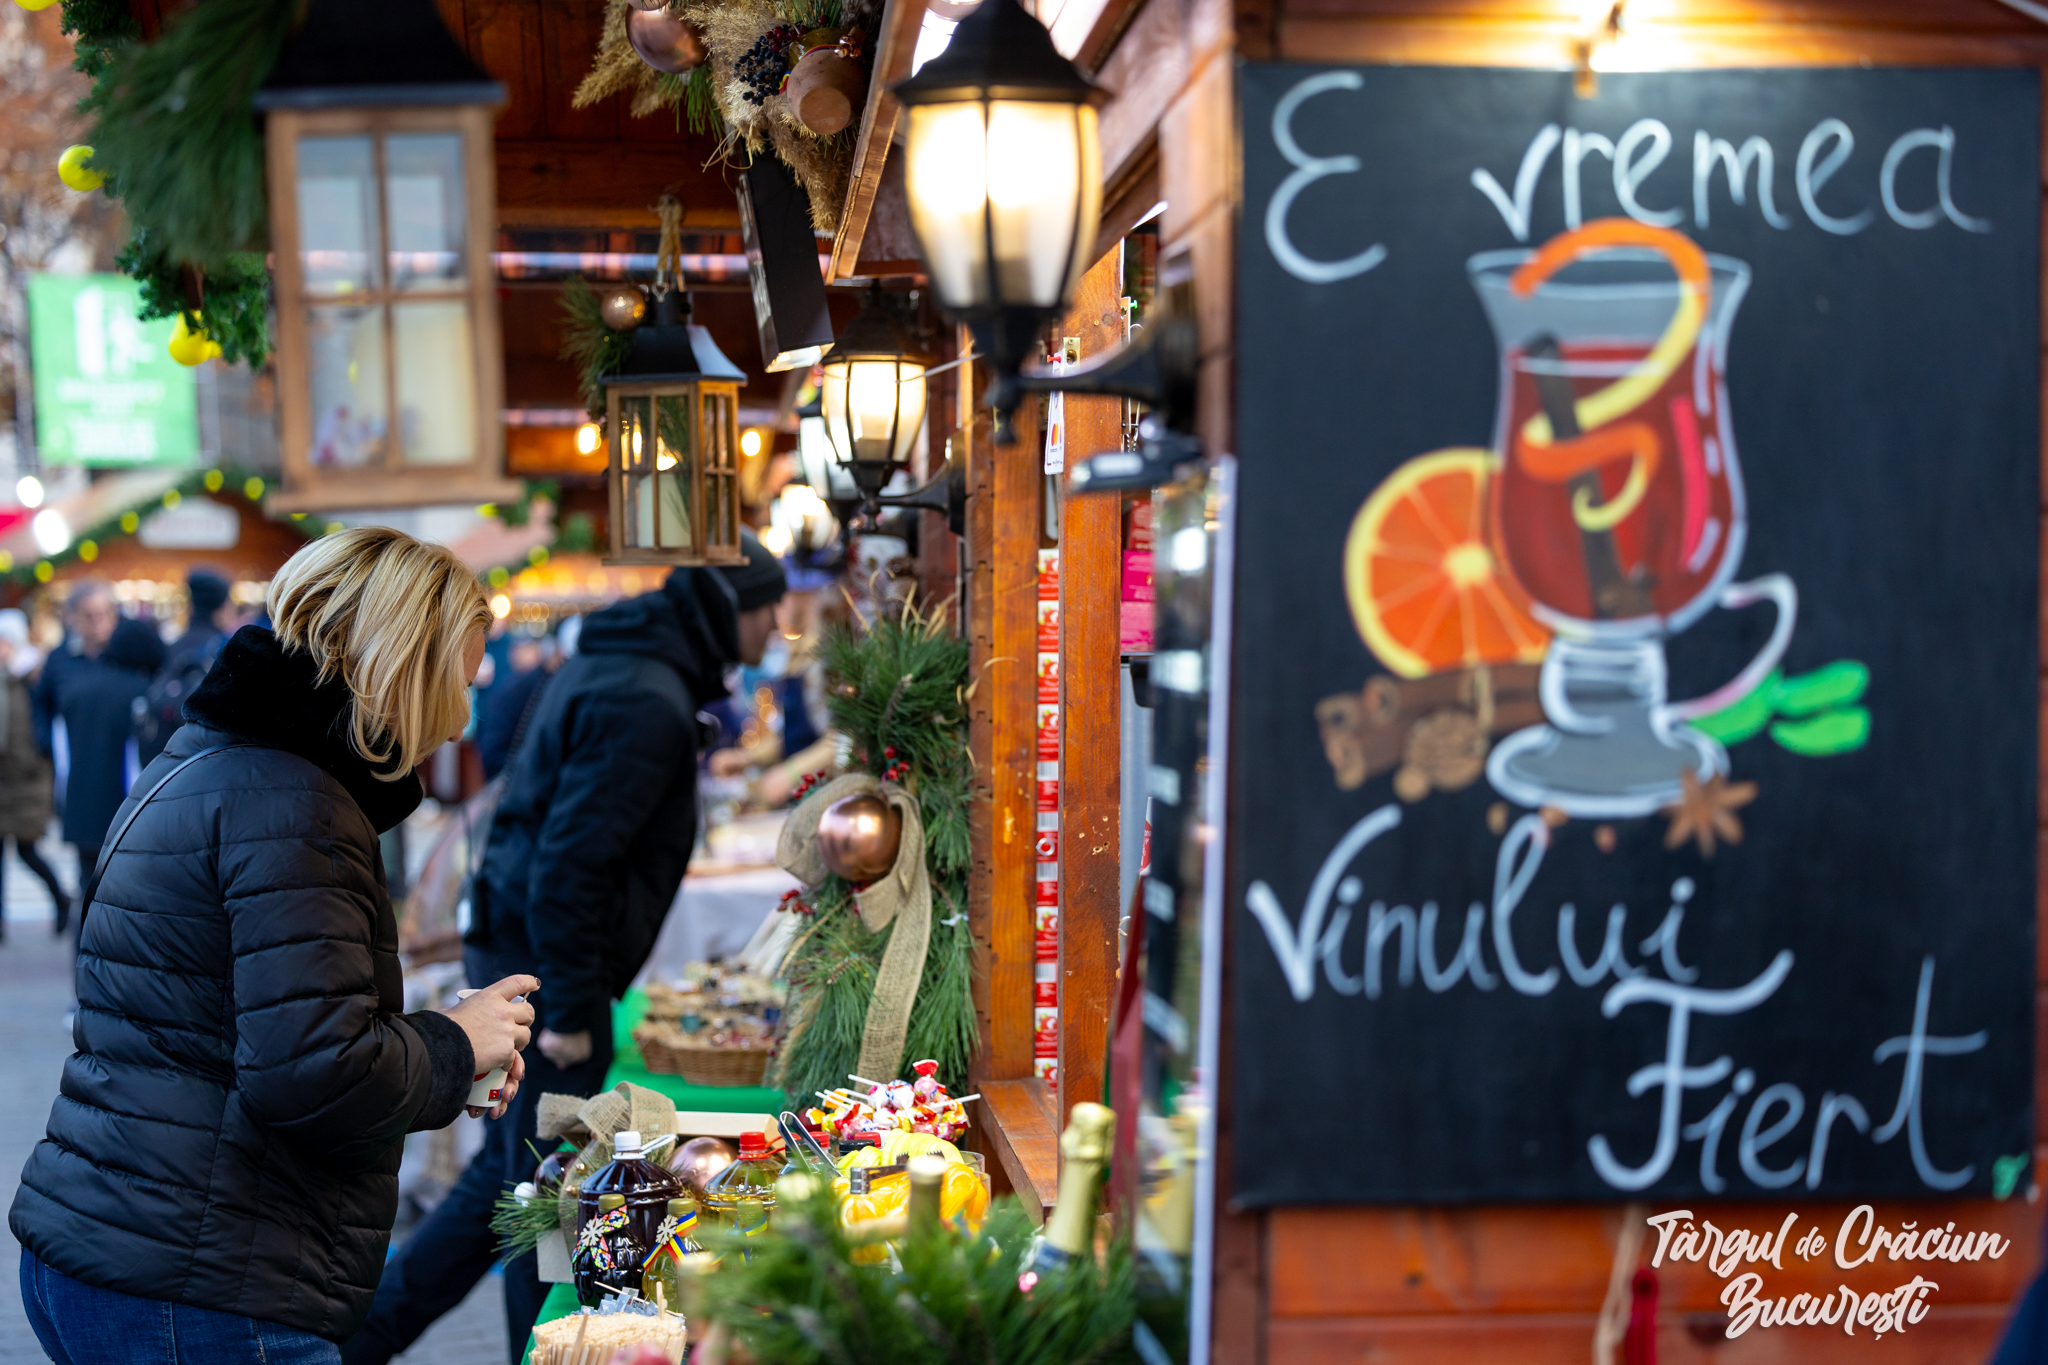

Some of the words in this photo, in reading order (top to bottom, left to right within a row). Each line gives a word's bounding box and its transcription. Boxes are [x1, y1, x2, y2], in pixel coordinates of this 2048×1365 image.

[1264, 71, 1387, 283] E
[1470, 117, 1992, 241] vremea
[1246, 803, 1699, 1001] Vinului
[1587, 948, 1988, 1194] Fiert
